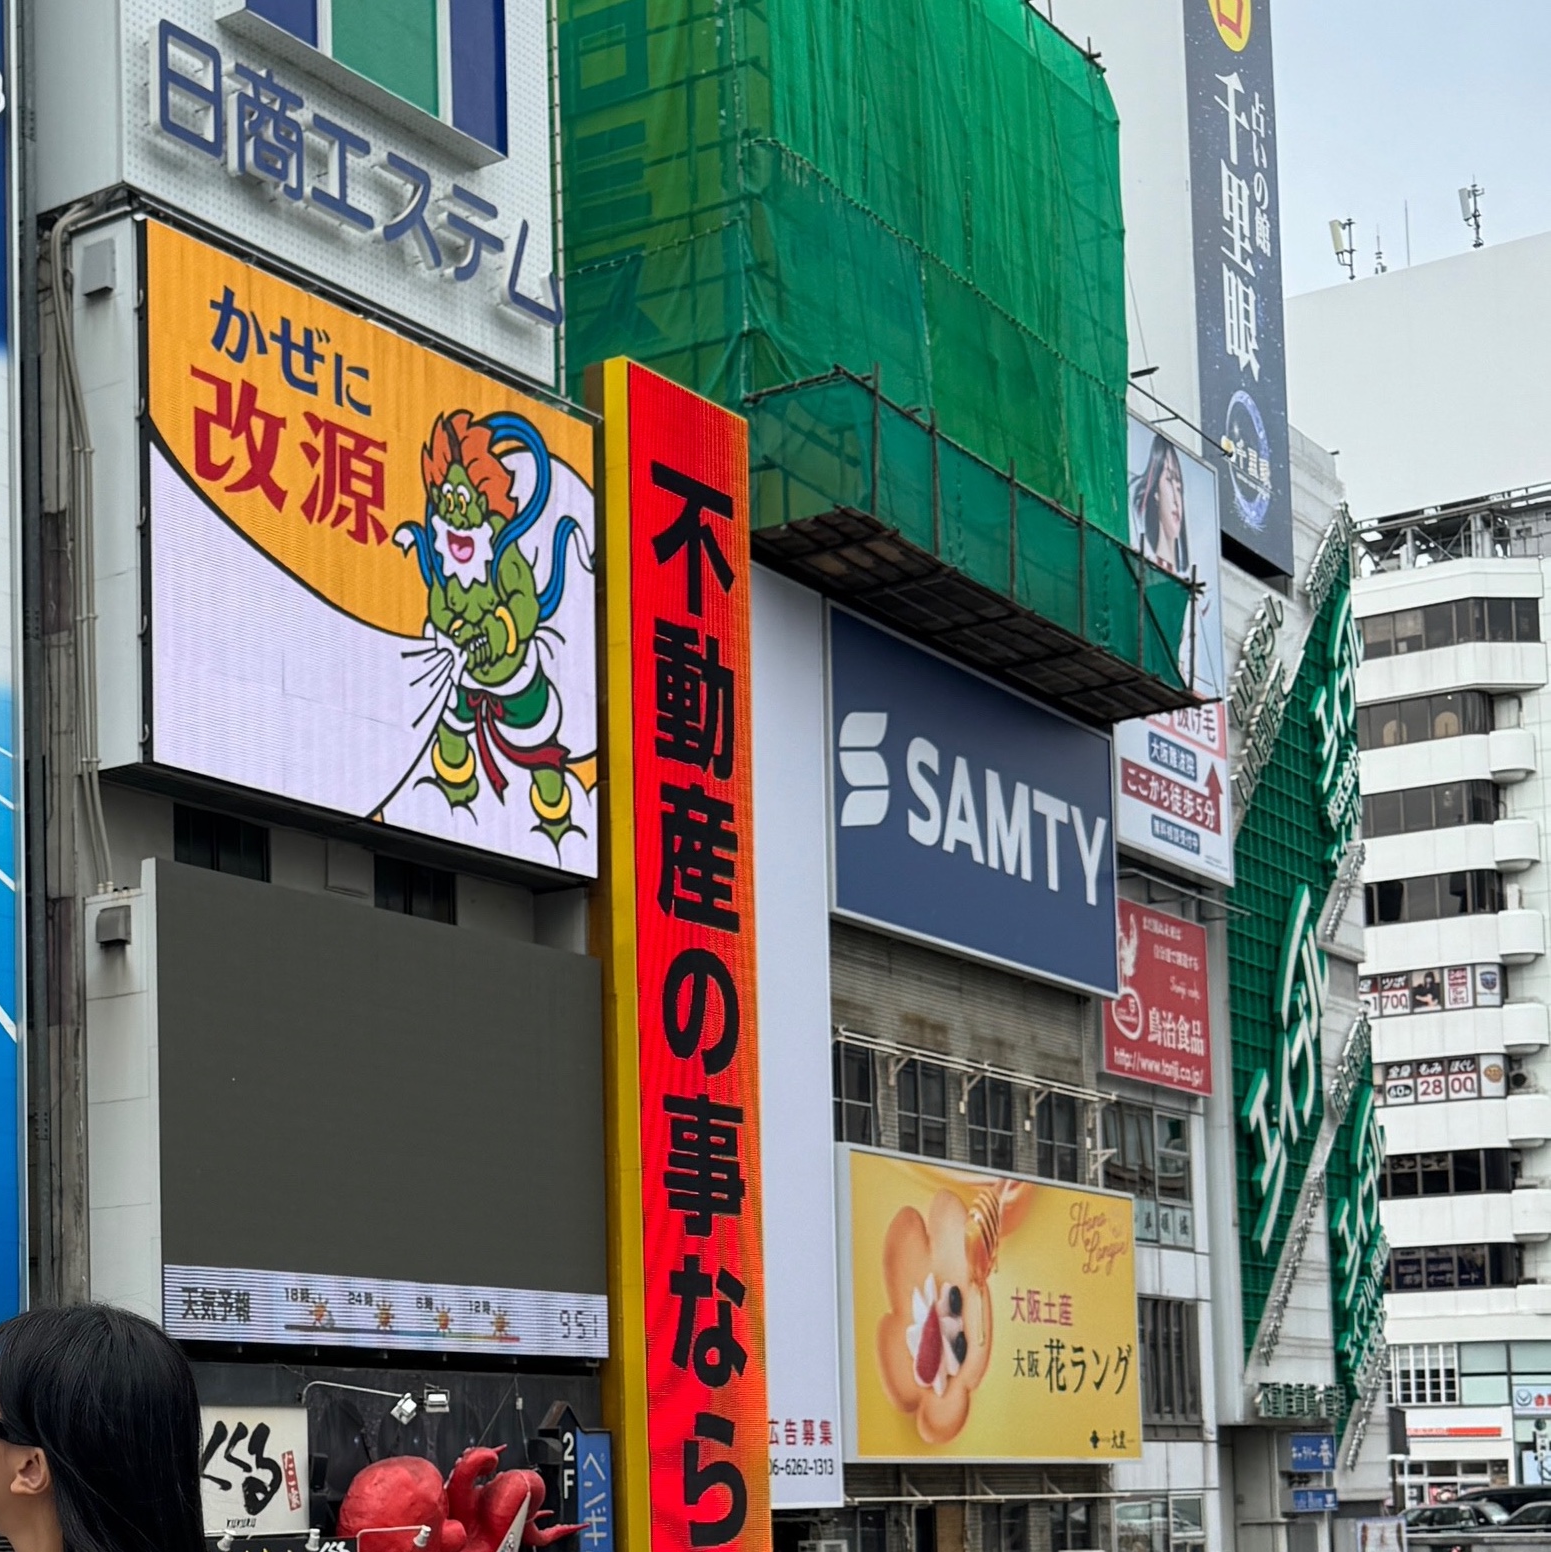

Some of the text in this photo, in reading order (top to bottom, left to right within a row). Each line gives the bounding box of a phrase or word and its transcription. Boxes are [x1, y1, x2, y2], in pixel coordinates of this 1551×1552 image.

[158, 18, 564, 328] 日商エステム
[1214, 72, 1260, 381] 千里眼
[209, 285, 372, 417] かぜに
[189, 364, 389, 547] 改源
[907, 735, 1107, 907] SAMTY
[1128, 768, 1215, 828] ここから徒歩5分
[650, 461, 751, 1552] 不動産の事なら
[181, 1285, 251, 1324] 天気予報
[1011, 1287, 1074, 1327] 大阪土産
[1013, 1337, 1132, 1395] 大阪 花ラング
[201, 1420, 282, 1516] くくる
[768, 1419, 832, 1446] 広告募集
